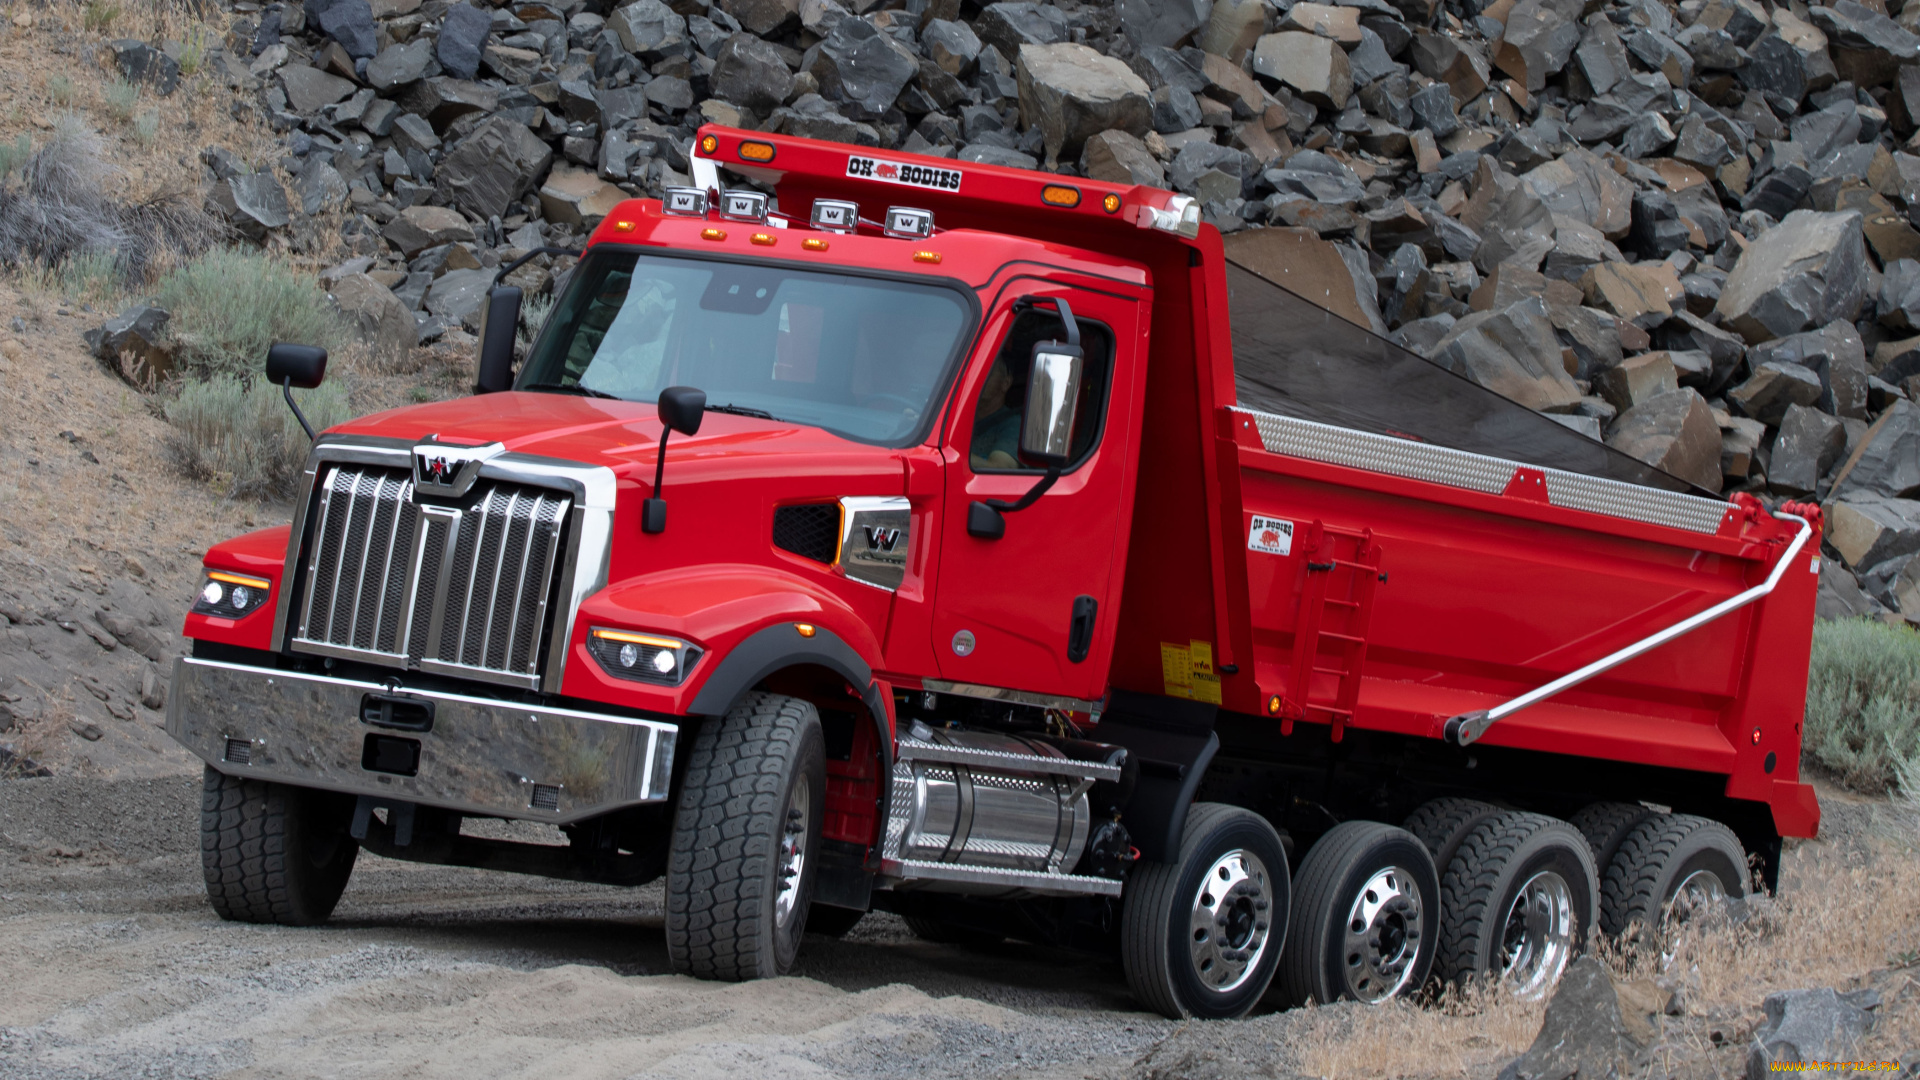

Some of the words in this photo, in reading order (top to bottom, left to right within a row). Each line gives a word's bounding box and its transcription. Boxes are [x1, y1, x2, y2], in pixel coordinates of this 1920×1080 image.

[848, 157, 874, 177] OX
[899, 165, 960, 189] BODIES
[1266, 520, 1292, 536] BODIES
